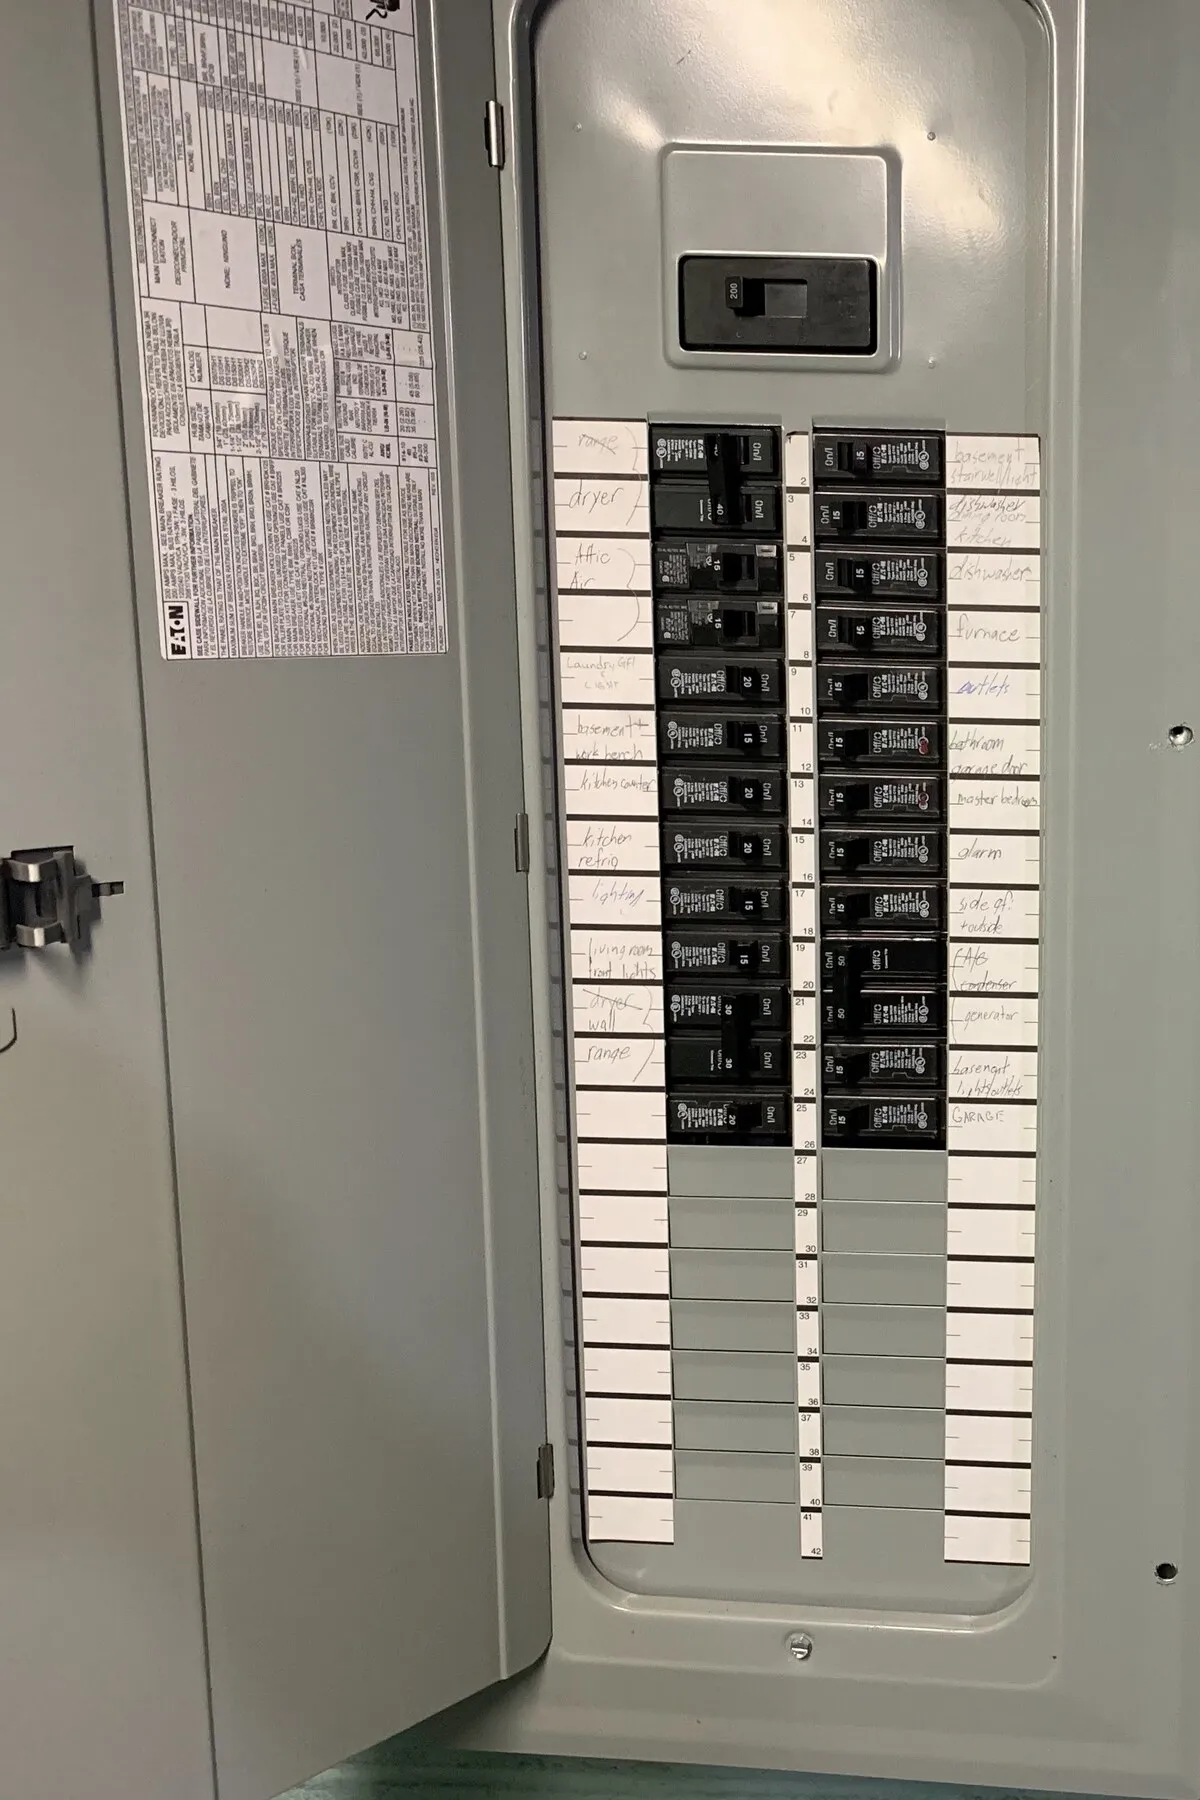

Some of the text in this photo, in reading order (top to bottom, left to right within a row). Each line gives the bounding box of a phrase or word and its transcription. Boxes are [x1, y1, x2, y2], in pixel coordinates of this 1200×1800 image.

[730, 283, 738, 299] 200
[569, 479, 624, 514] dryer
[956, 613, 1020, 642] furnace
[836, 738, 843, 748] 15
